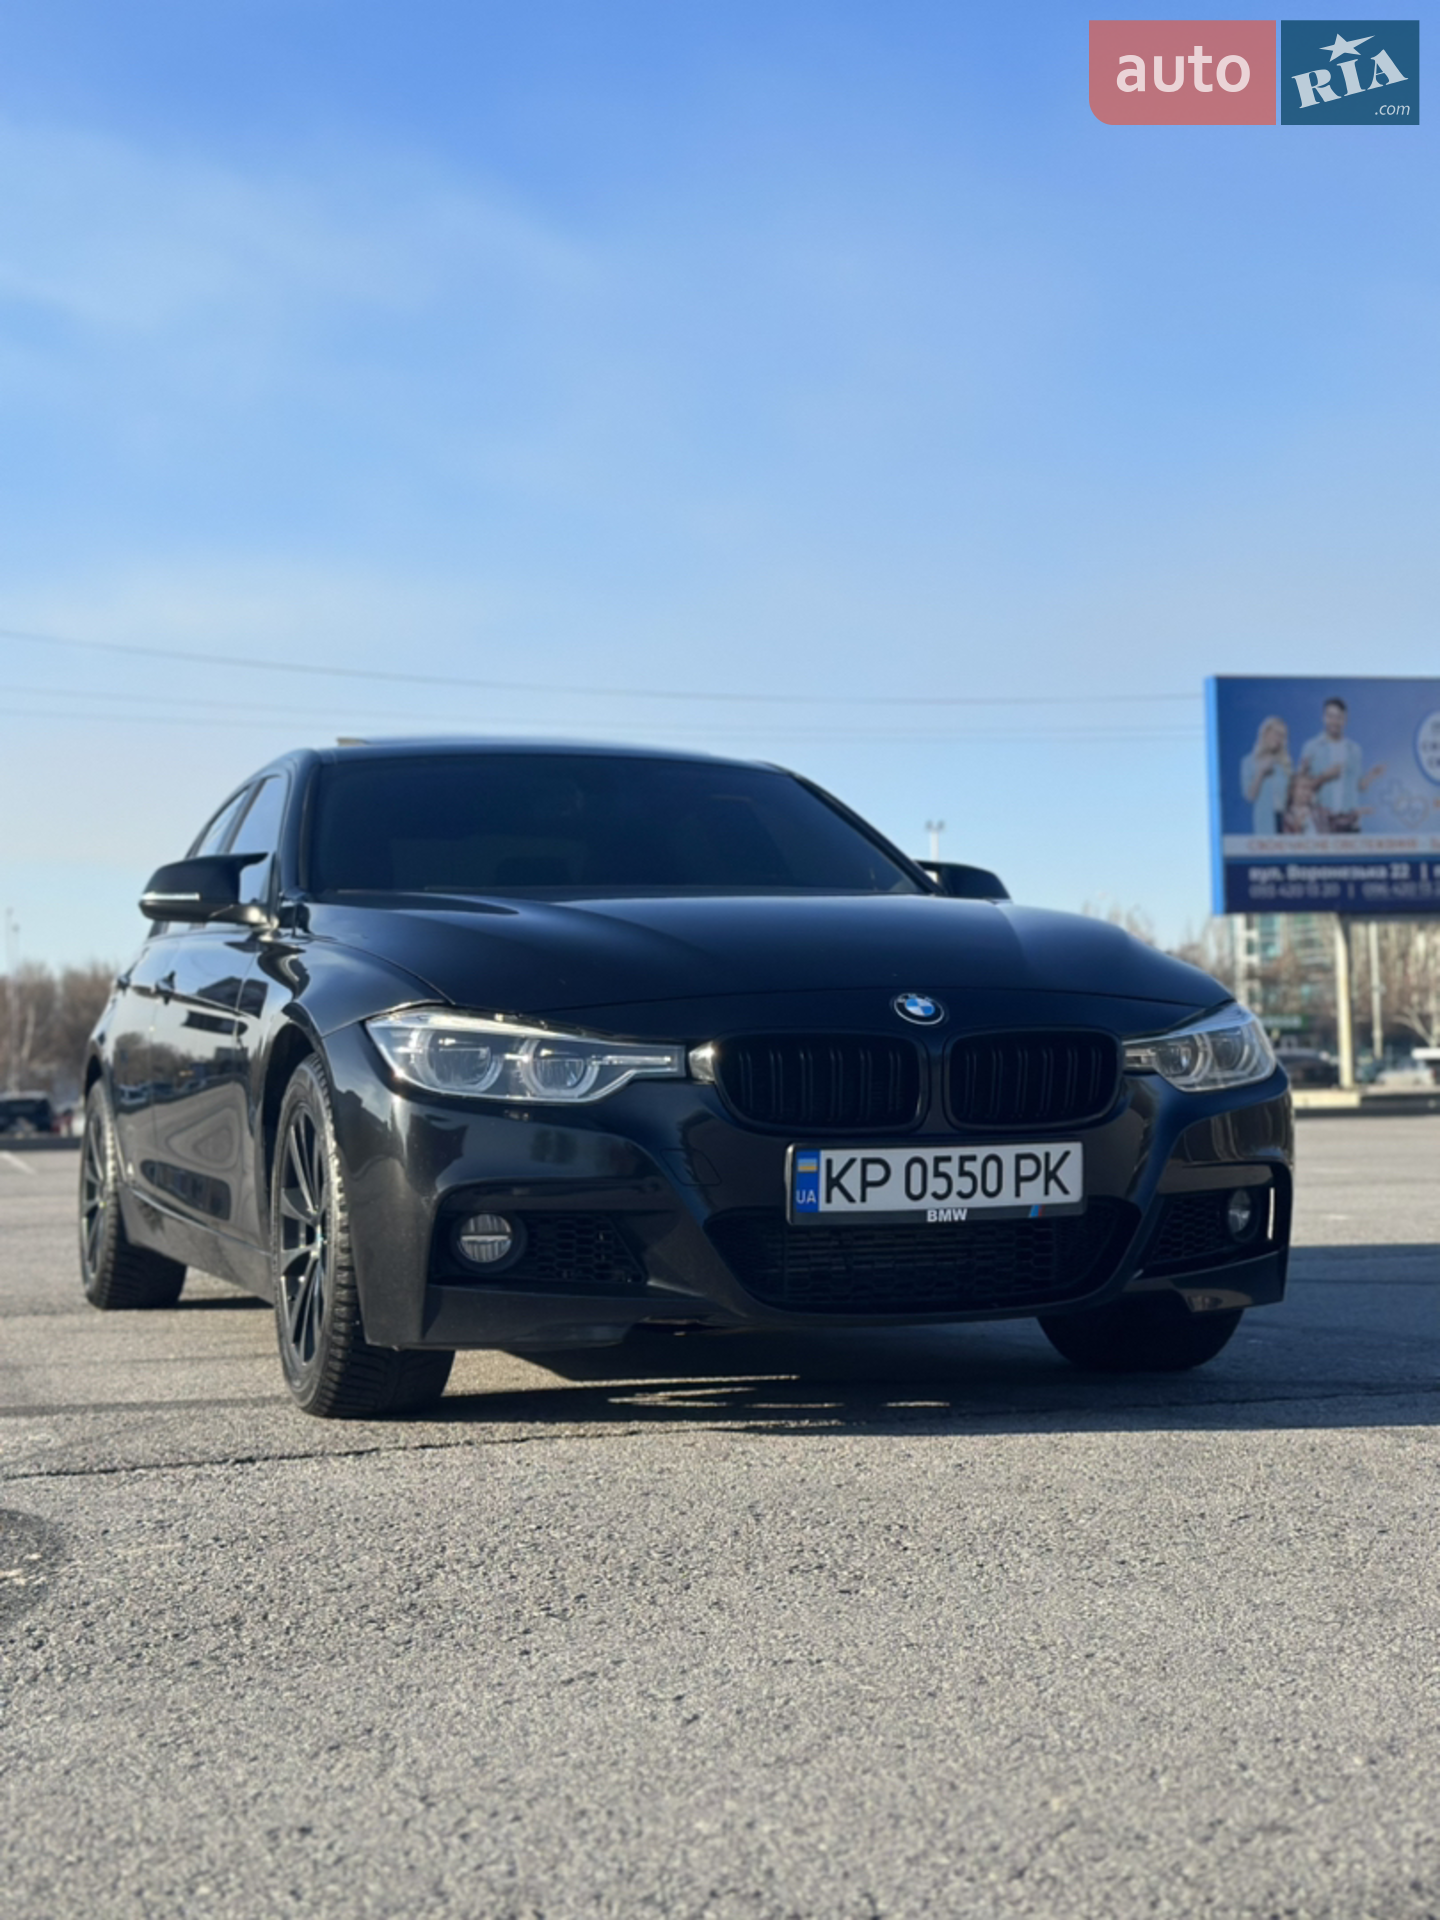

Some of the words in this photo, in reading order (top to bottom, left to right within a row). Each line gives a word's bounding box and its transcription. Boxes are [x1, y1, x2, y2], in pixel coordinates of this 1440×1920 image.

[825, 1157, 892, 1204] KP
[904, 1154, 1003, 1201] 0550
[1014, 1150, 1071, 1198] PK
[796, 1189, 817, 1204] UA
[927, 1208, 968, 1222] BMW
